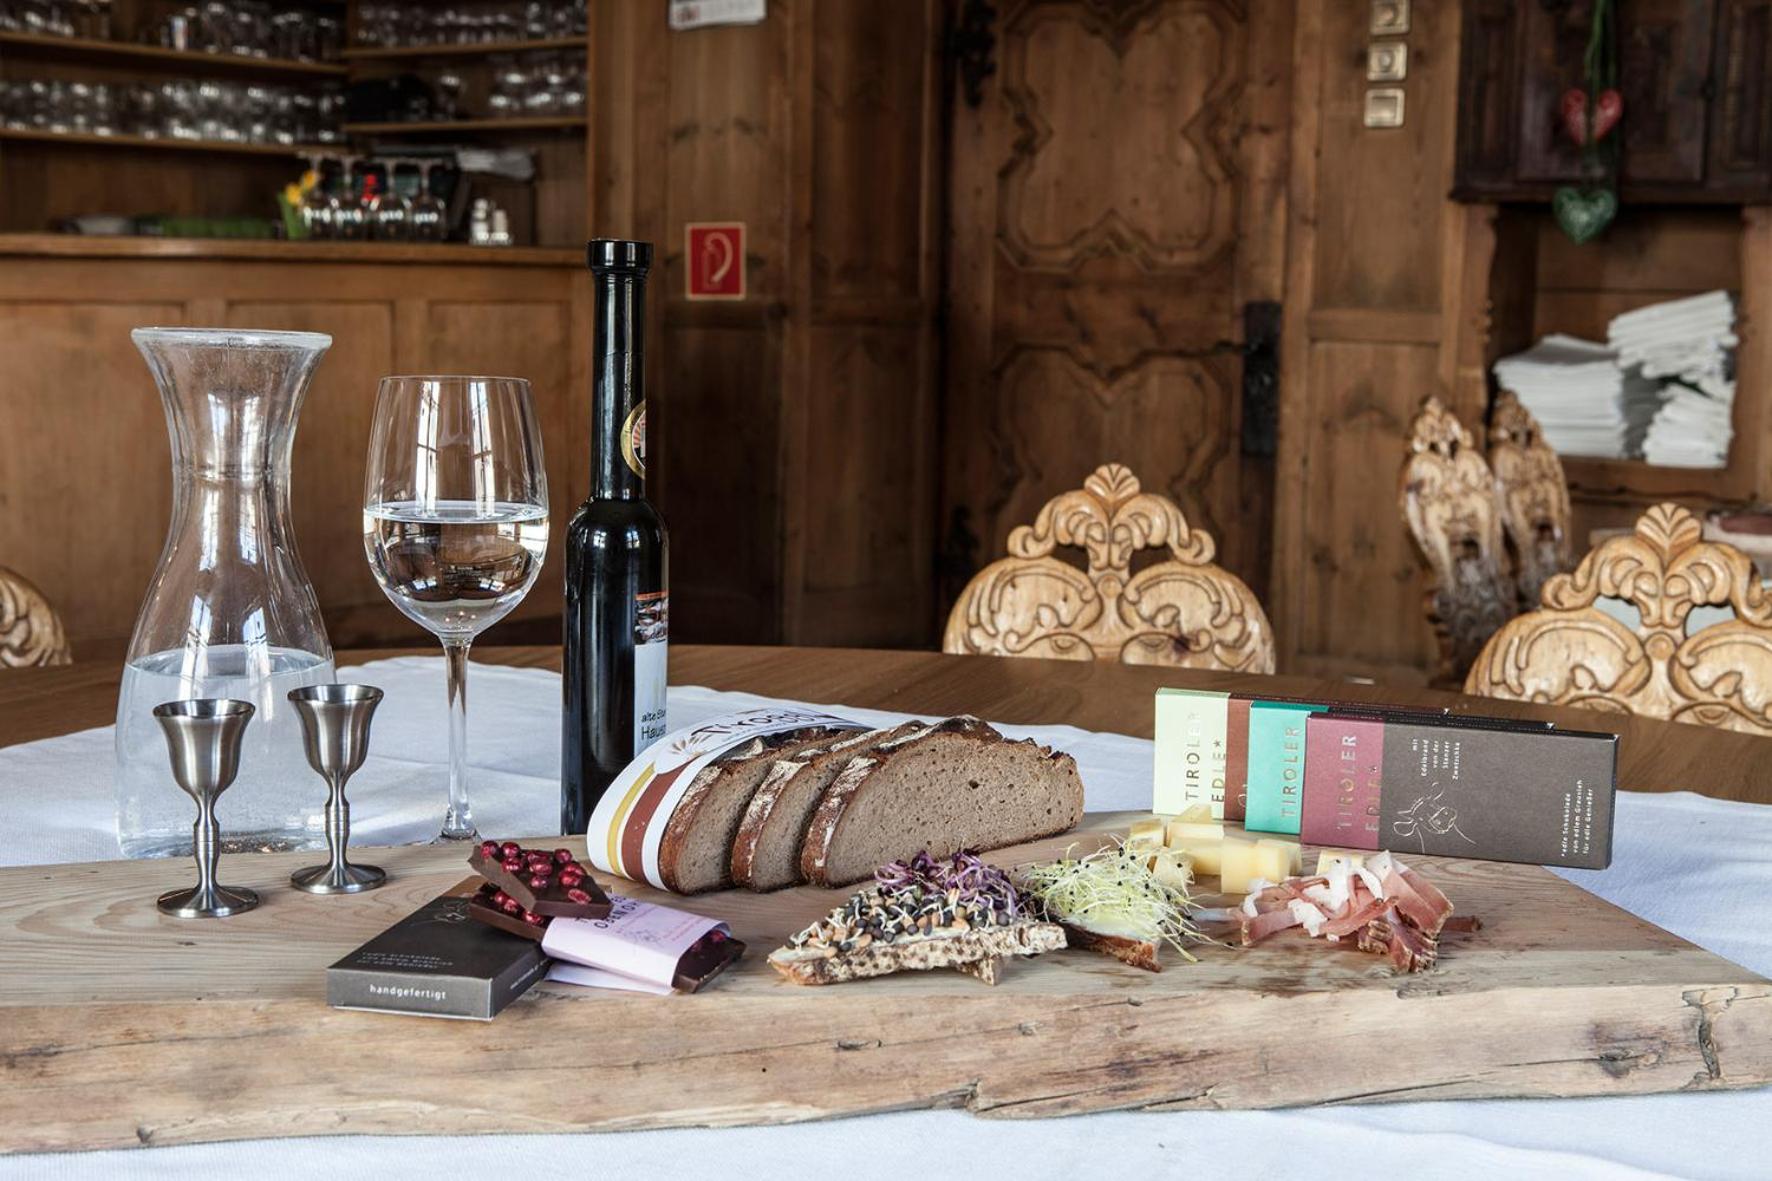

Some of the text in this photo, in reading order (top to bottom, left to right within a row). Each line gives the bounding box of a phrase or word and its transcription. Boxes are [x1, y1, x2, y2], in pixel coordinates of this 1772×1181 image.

[1184, 712, 1201, 801] TIROLER
[1411, 738, 1419, 752] mit
[1420, 739, 1429, 777] Edelbrand
[1281, 726, 1300, 819] TIROLER
[1338, 734, 1358, 831] TIROLER
[1562, 793, 1571, 835] Schokolade
[1573, 815, 1581, 838] edlem
[368, 983, 447, 1001] handgefertigt
